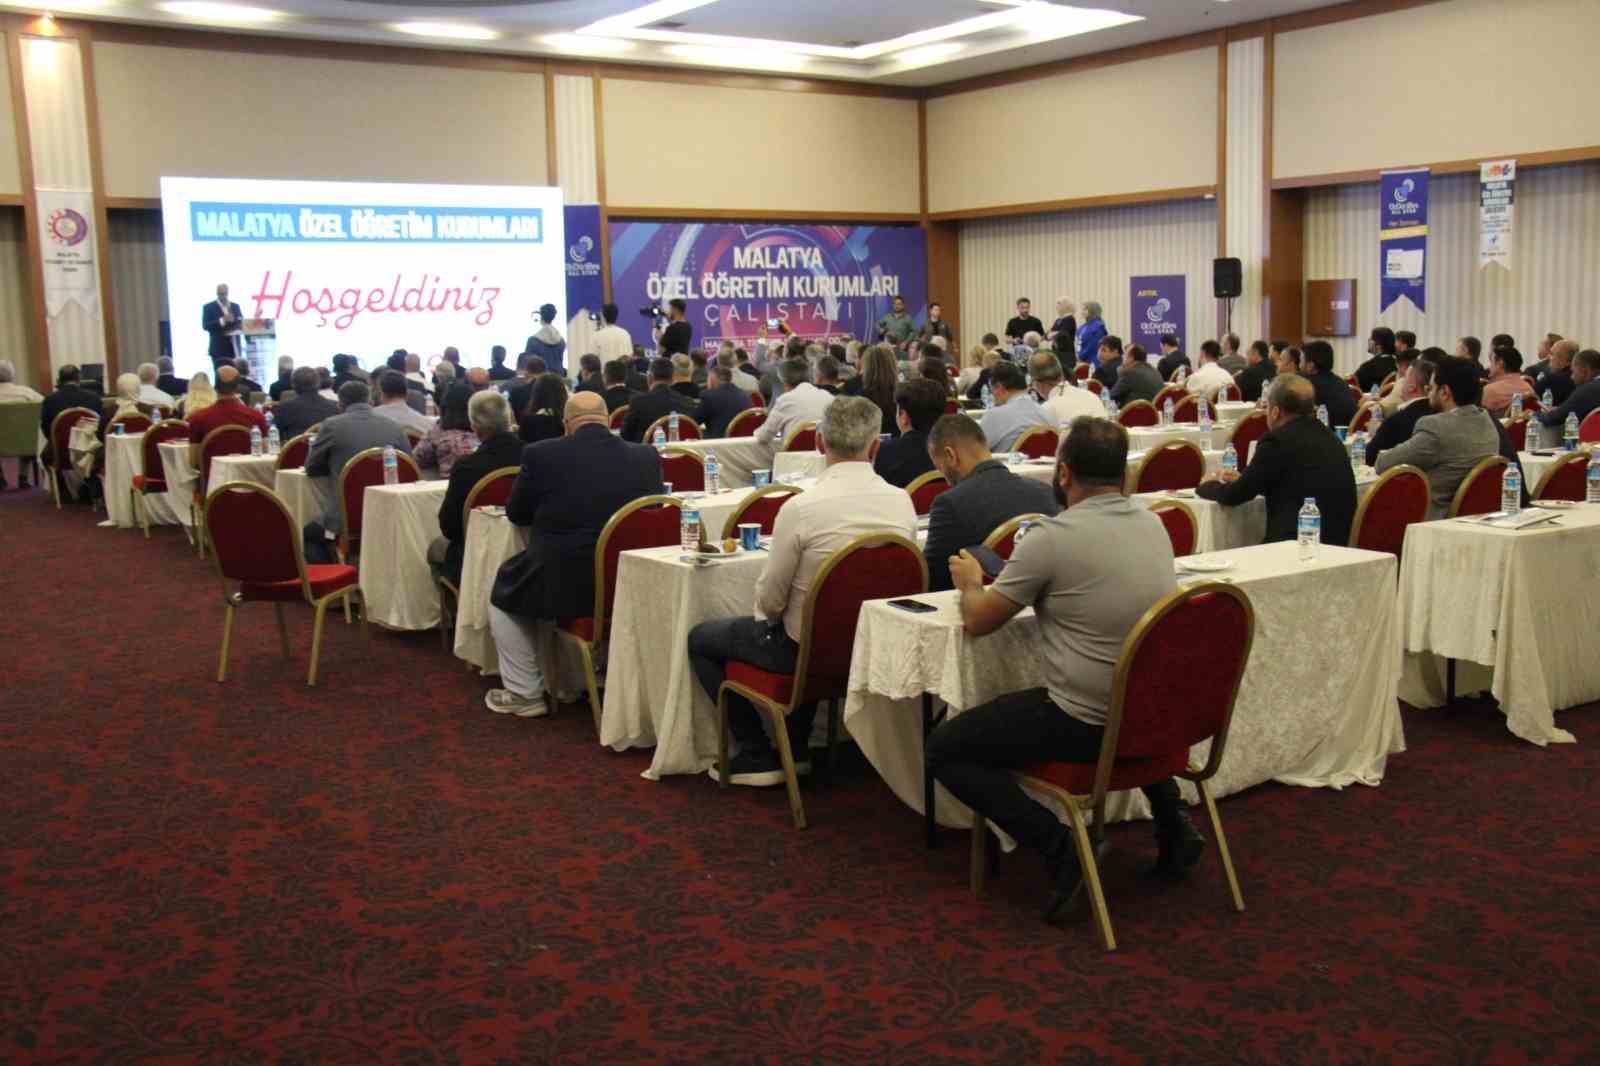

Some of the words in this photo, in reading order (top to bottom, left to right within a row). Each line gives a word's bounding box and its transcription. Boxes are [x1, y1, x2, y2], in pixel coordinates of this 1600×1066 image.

[196, 211, 296, 238] MALATYA
[300, 208, 348, 239] ÖZEL
[351, 208, 434, 240] ÖĞRETİM
[733, 246, 823, 270] MALATYA
[251, 270, 501, 330] Hoşgeldiniz
[646, 272, 699, 300] ÖZEL
[702, 271, 789, 299] ÖĞRETİM
[793, 275, 899, 298] KURUMLARI
